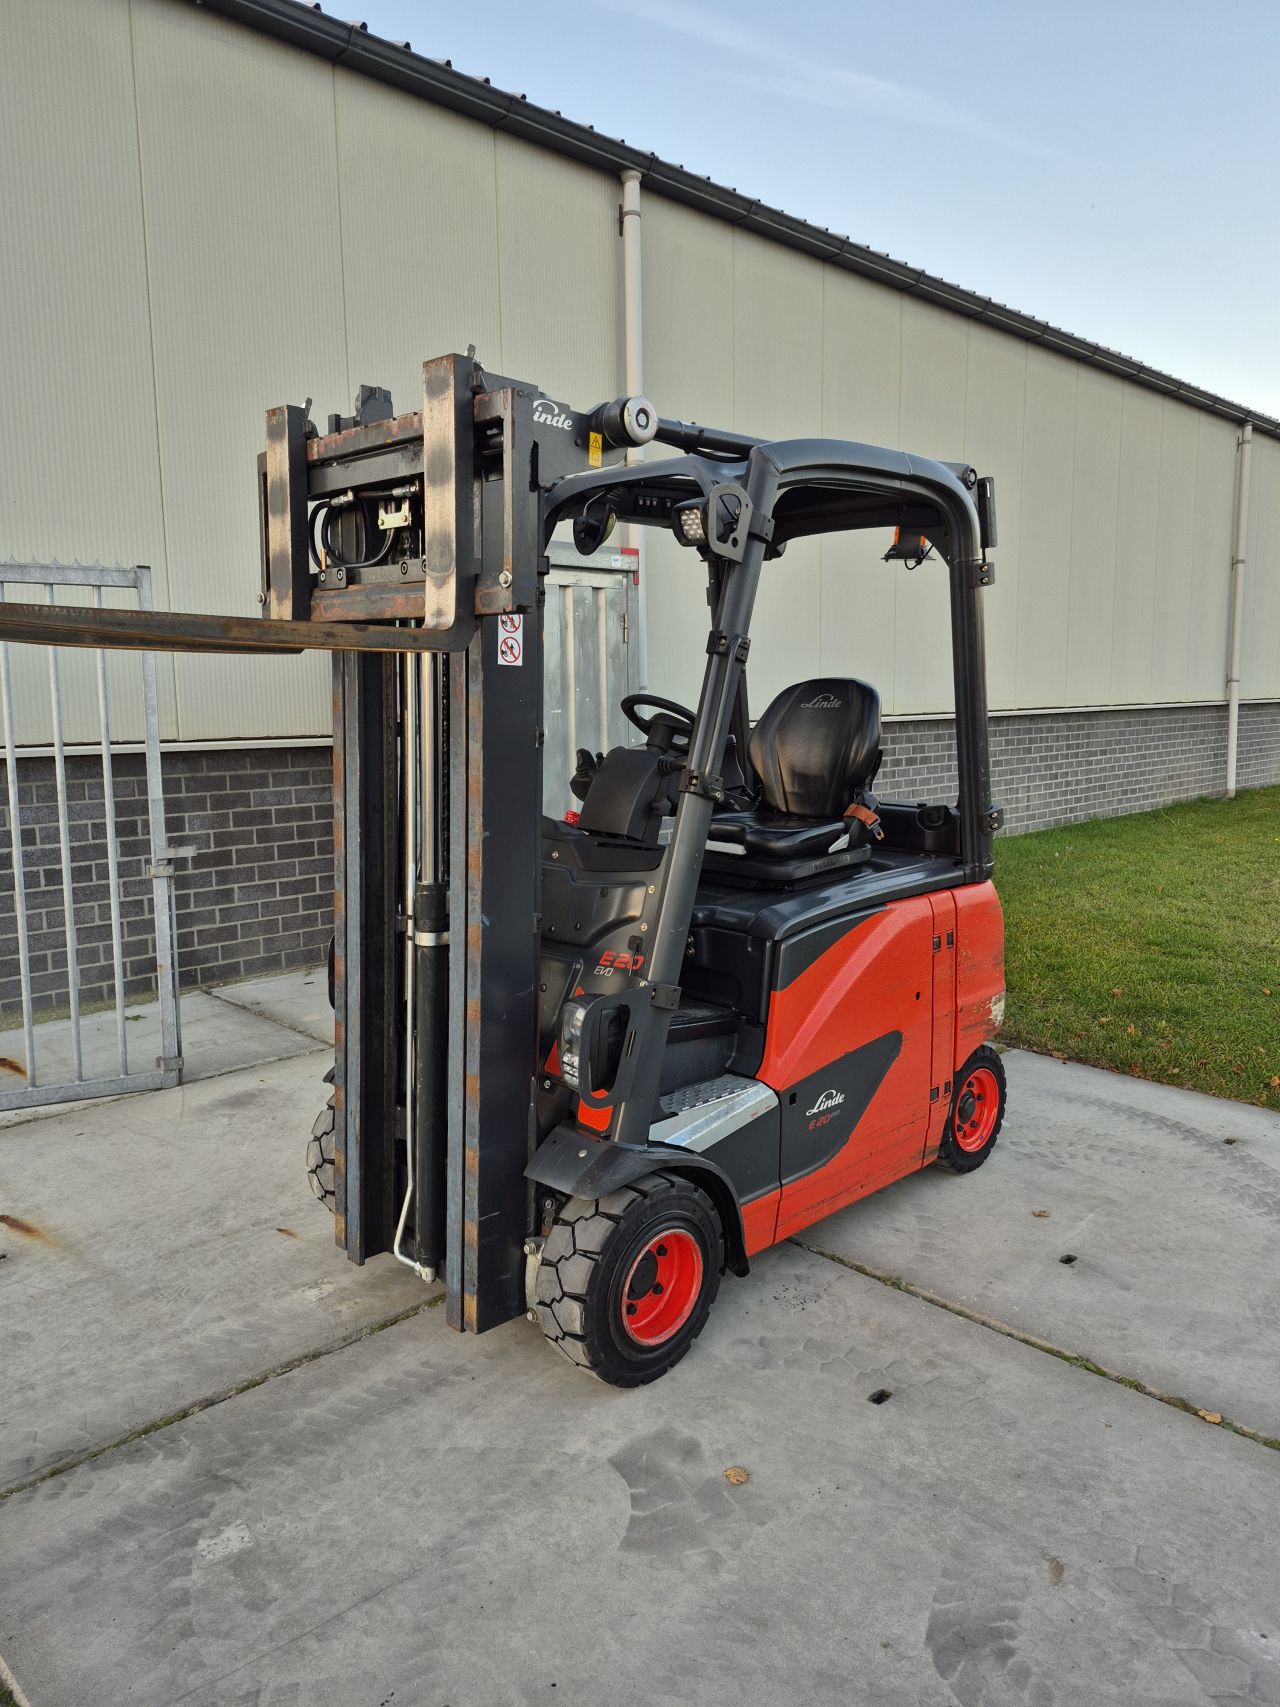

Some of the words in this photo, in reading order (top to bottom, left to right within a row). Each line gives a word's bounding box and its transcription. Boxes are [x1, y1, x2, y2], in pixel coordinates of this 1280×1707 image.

[800, 693, 842, 708] Linde
[594, 965, 614, 977] EVO
[806, 1089, 845, 1116] Linde
